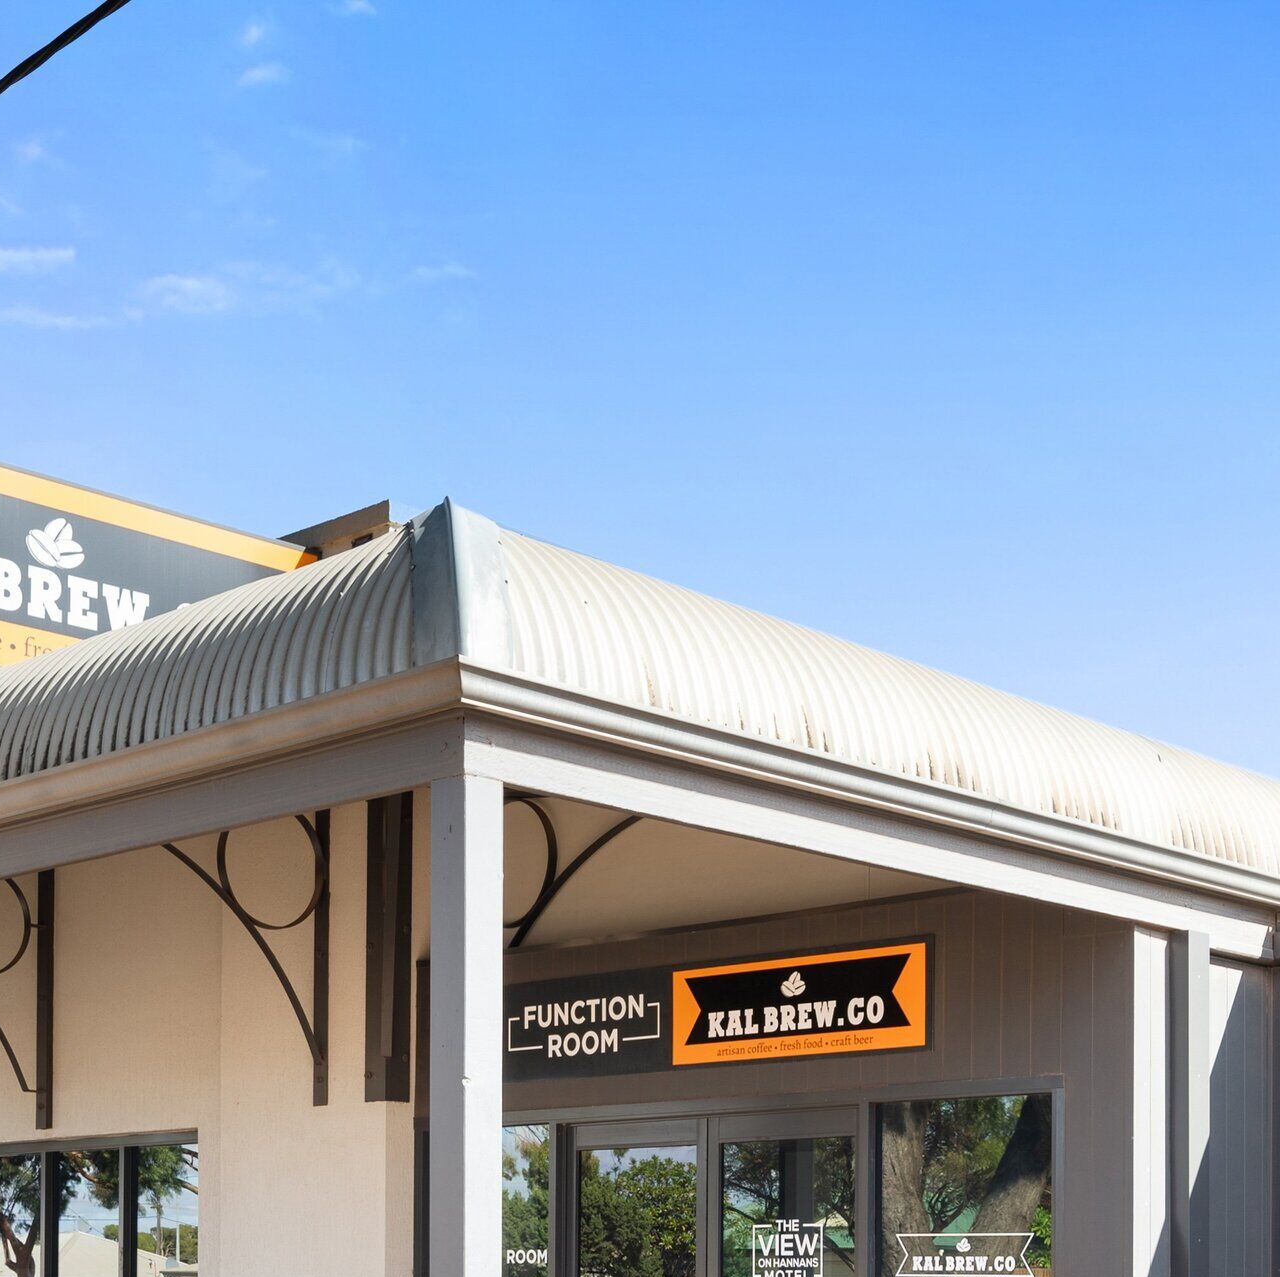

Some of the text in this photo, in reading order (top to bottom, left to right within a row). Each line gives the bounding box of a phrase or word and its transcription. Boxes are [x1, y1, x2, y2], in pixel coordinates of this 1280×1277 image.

[524, 993, 644, 1030] FUNCTION
[707, 995, 885, 1039] KAL BREW.CO
[548, 1028, 618, 1058] ROOM
[717, 1034, 874, 1057] artisan coffee fresh food craft beer
[775, 1219, 800, 1232] THE
[757, 1233, 819, 1256] VIEW
[506, 1249, 548, 1264] ROOM
[758, 1257, 819, 1268] ON HANNANS
[912, 1255, 1016, 1272] KAL BREW.CO
